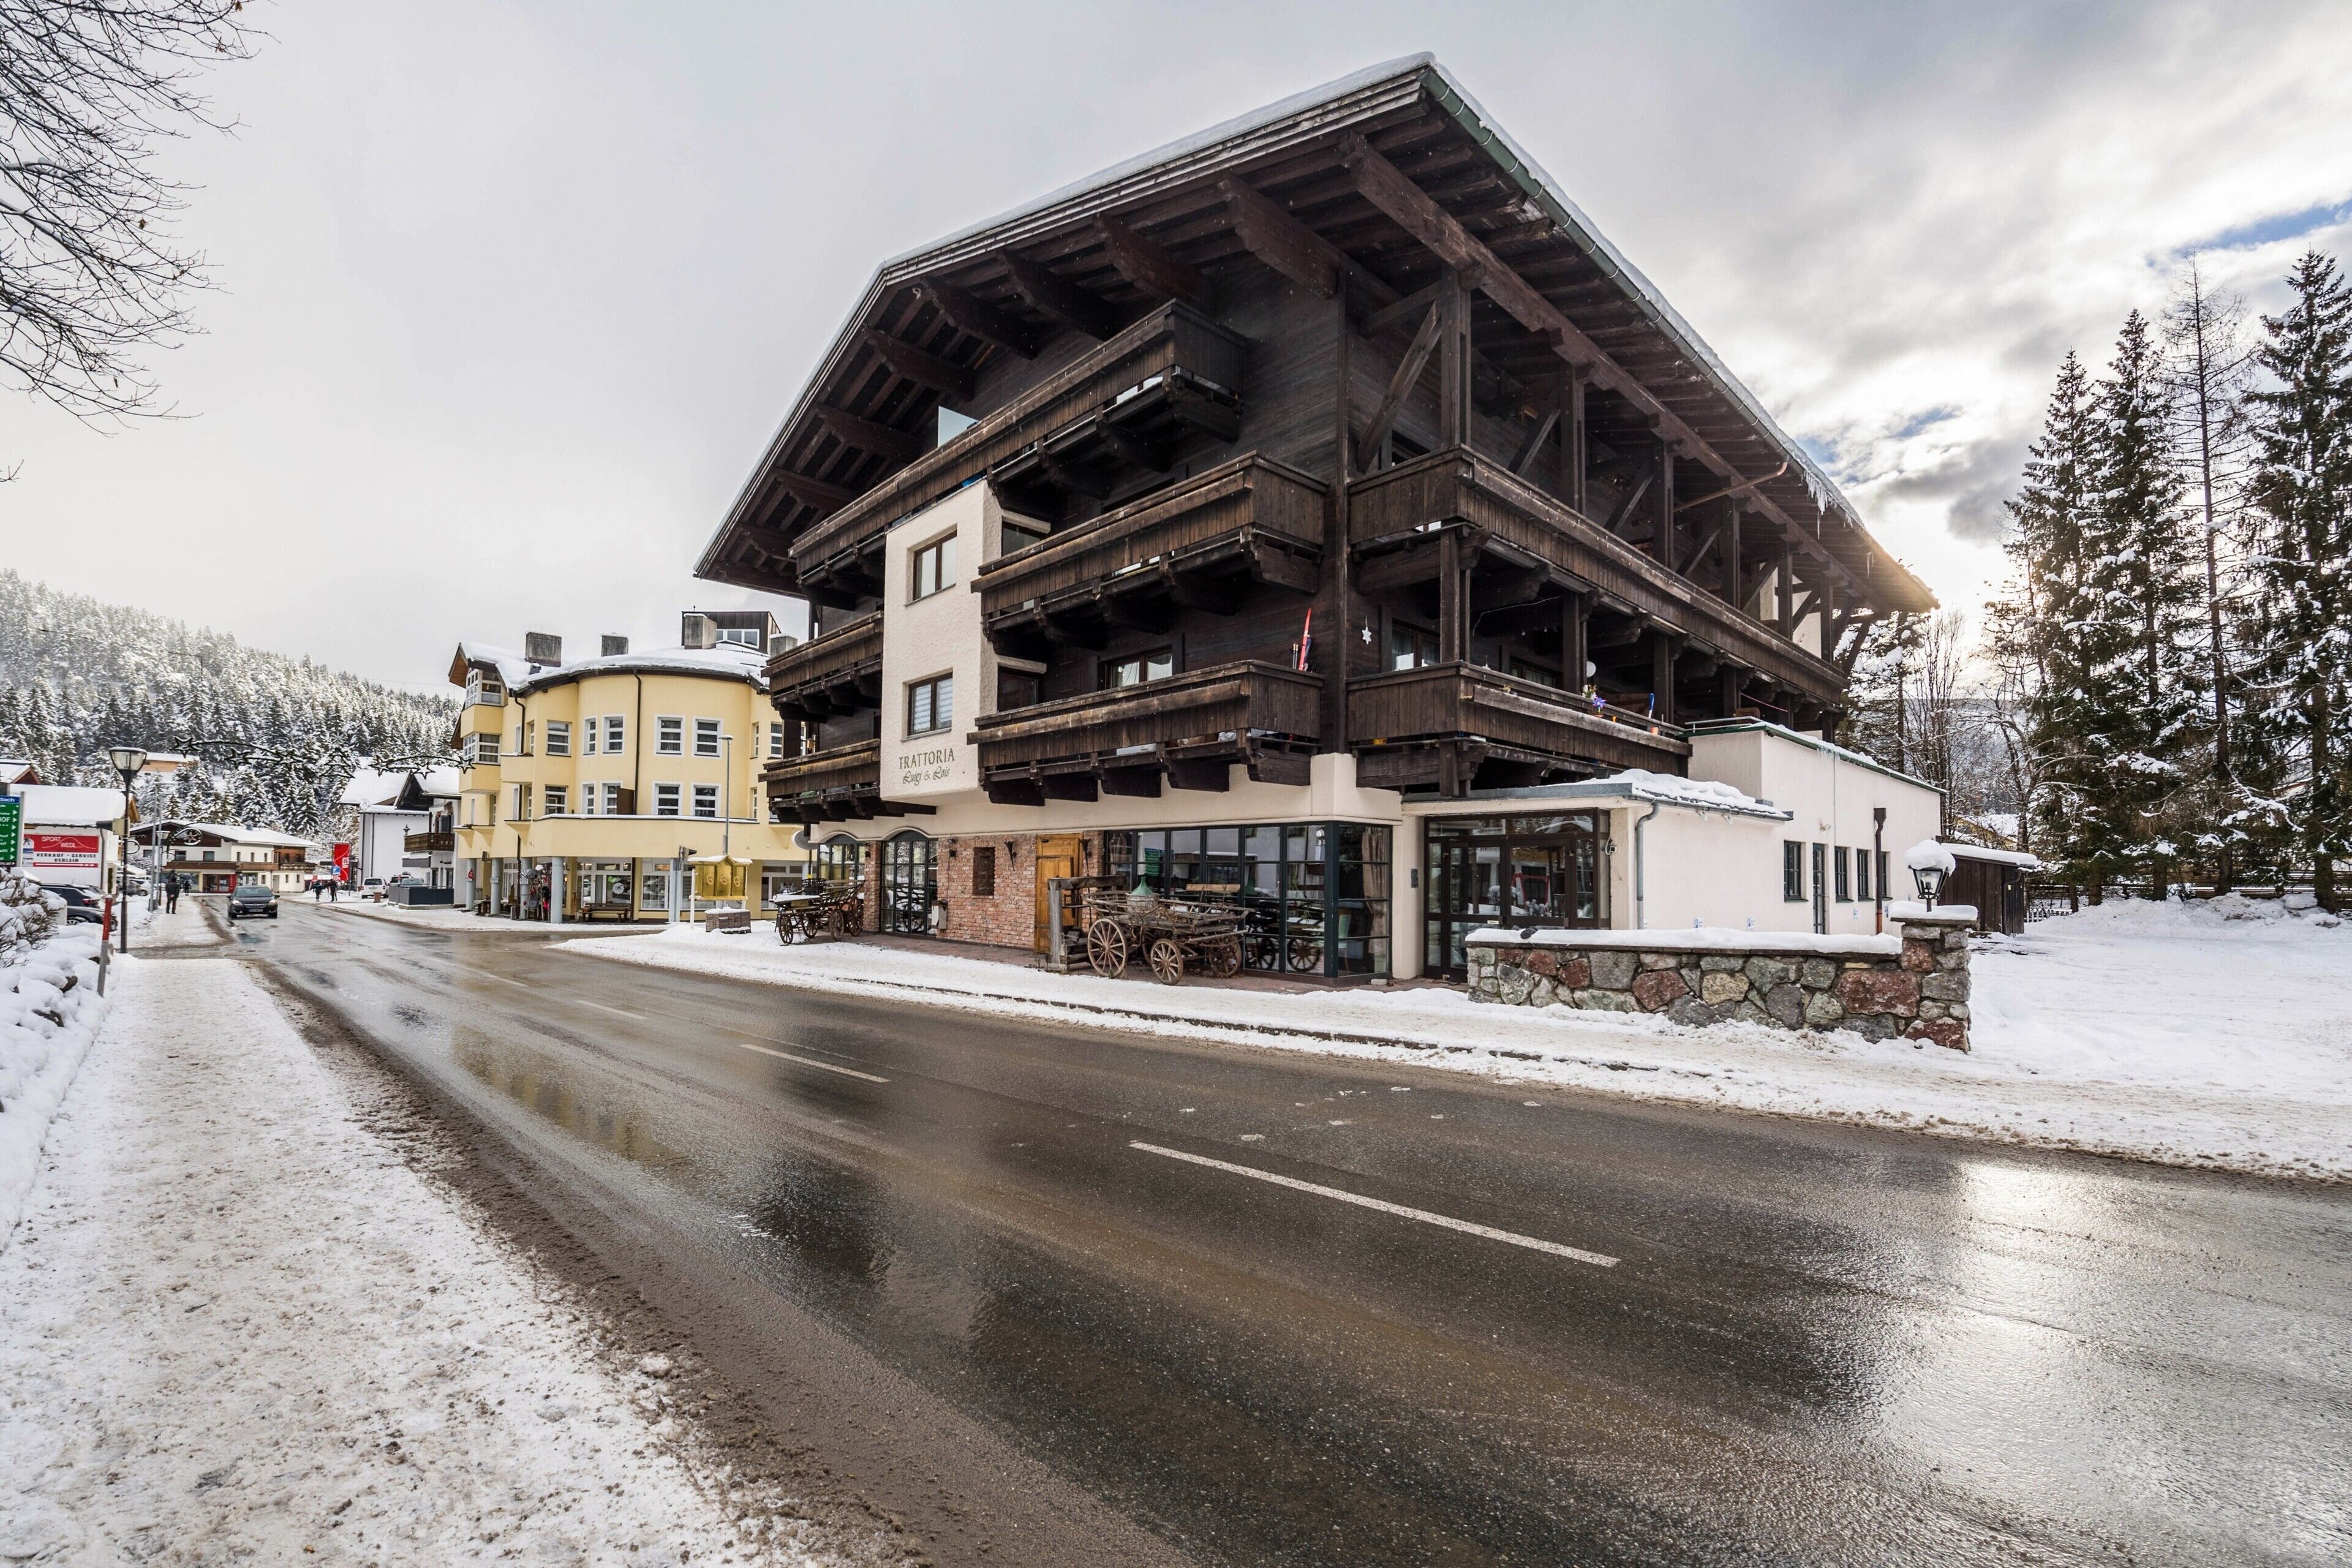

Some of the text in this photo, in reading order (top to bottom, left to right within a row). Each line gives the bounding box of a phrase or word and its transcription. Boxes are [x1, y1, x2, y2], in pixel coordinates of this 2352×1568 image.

[899, 748, 955, 769] TRATTORIA
[902, 766, 951, 786] Luigi & Lois
